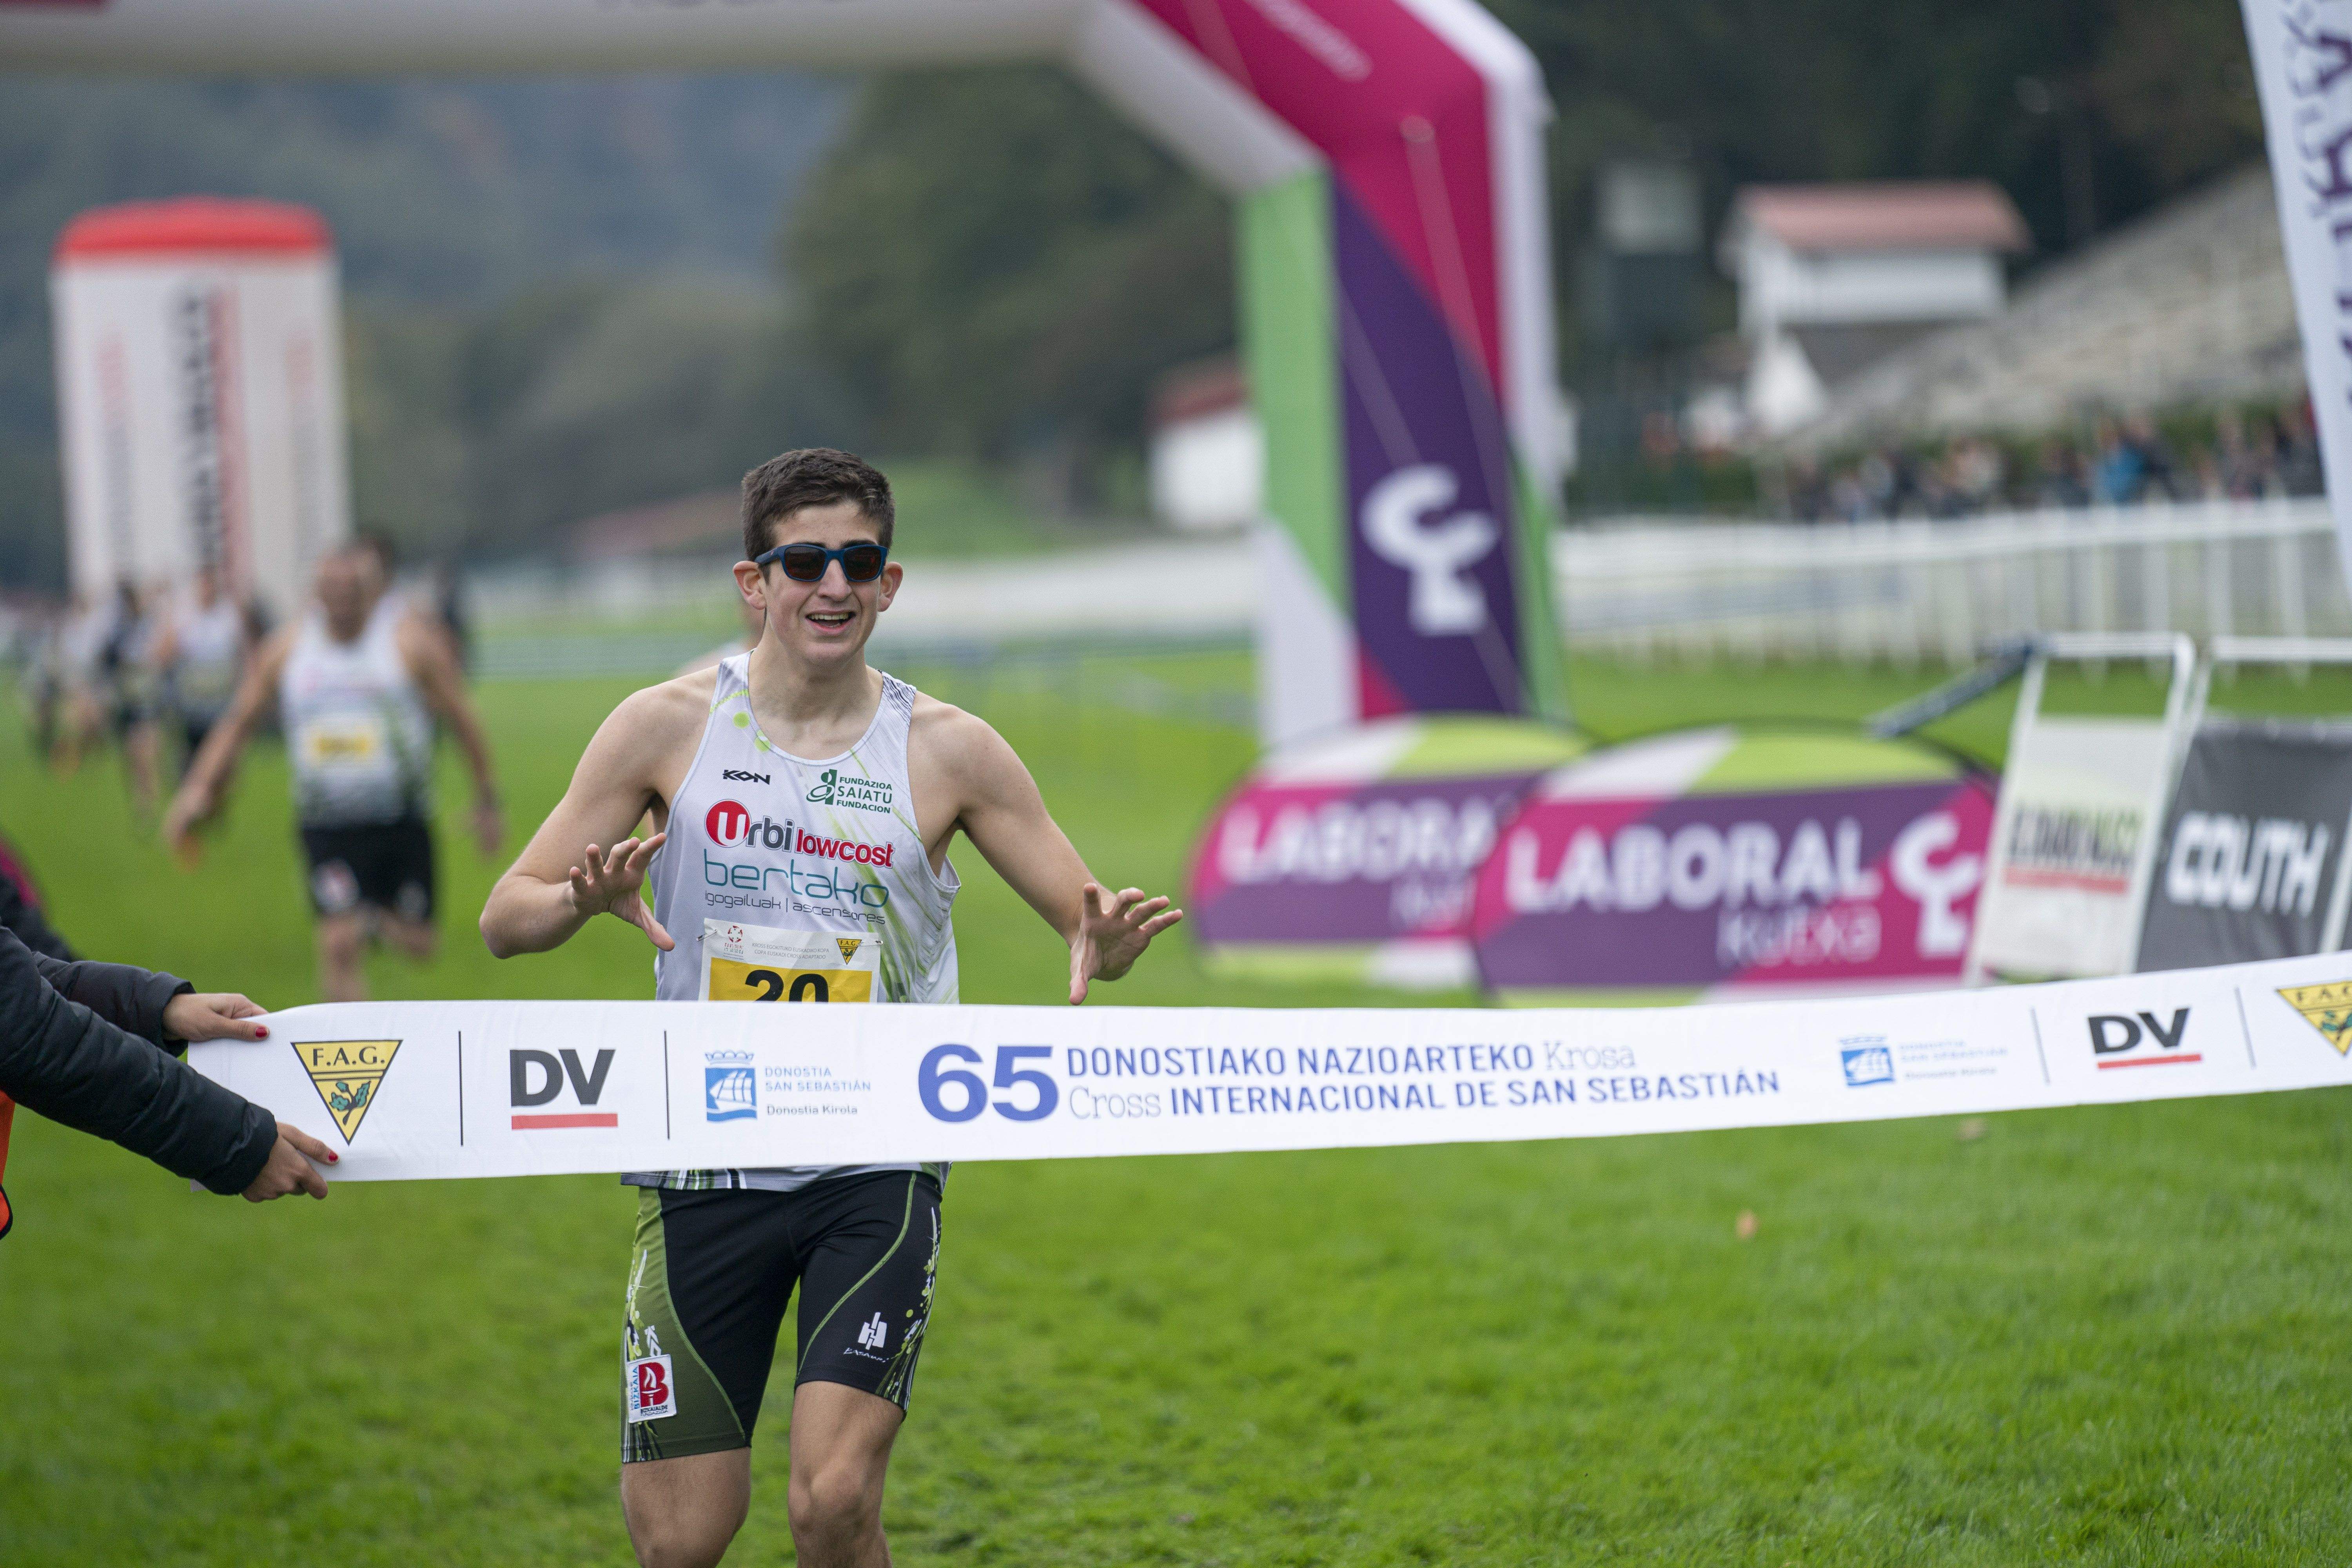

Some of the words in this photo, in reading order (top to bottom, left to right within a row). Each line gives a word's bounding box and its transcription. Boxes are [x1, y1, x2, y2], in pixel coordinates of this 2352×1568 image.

[837, 786, 893, 804] SAIATU
[840, 777, 892, 791] FUNDAZIOA
[837, 799, 891, 814] FUNDACION
[1219, 799, 1497, 884] LABORA
[704, 848, 889, 908] bertako
[1505, 817, 1881, 914] LABORAL
[2166, 810, 2329, 917] COUTH
[705, 891, 781, 909] igogailuak
[793, 902, 886, 925] ascensores
[745, 969, 829, 1002] 20
[2087, 1006, 2192, 1055] DV
[313, 1046, 385, 1066] F.A.G.
[765, 1067, 832, 1077] DONOSTIA
[1067, 1047, 1285, 1076] DONOSTIAKO
[1297, 1044, 1534, 1075] NAZIOARTEKO
[1543, 1040, 1637, 1071] Krosa
[510, 1049, 616, 1108] DV
[766, 1081, 792, 1091] SAN
[797, 1079, 871, 1091] SEBASTIÁN
[918, 1044, 1059, 1122] 65
[1069, 1085, 1161, 1120] Cross
[1171, 1084, 1446, 1115] INTERNACIONAL
[1455, 1081, 1496, 1108] DE
[1507, 1078, 1577, 1106] SAN
[1588, 1066, 1780, 1102] SEBASTIÁN
[767, 1104, 819, 1115] Donostia
[822, 1104, 858, 1115] Kirola
